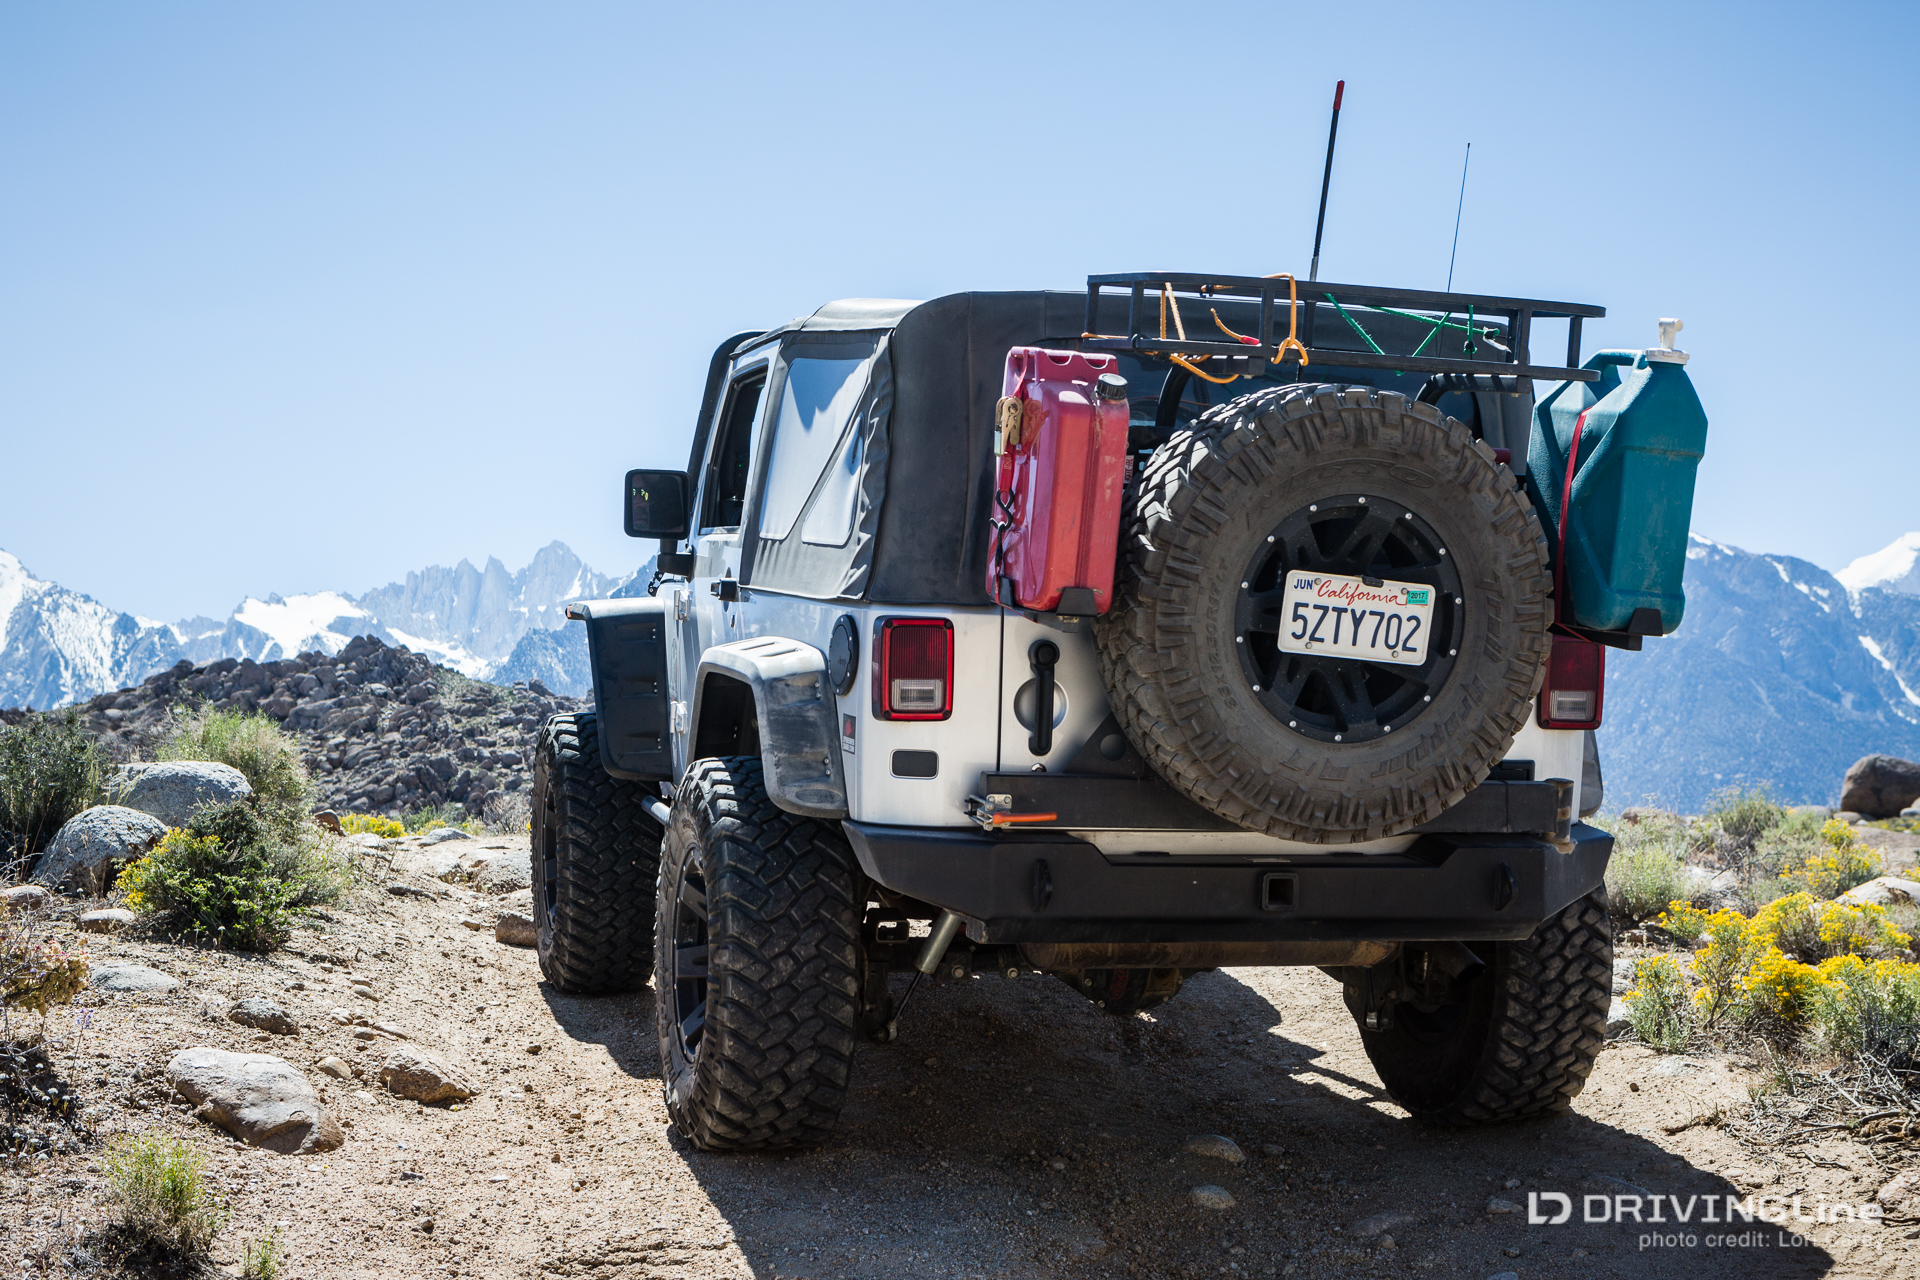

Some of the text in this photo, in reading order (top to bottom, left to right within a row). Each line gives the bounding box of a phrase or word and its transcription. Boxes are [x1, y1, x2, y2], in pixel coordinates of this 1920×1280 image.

[1294, 578, 1313, 590] JUN
[1317, 580, 1407, 606] California
[1410, 592, 1425, 600] 2017
[1291, 601, 1422, 653] 5ZTY702
